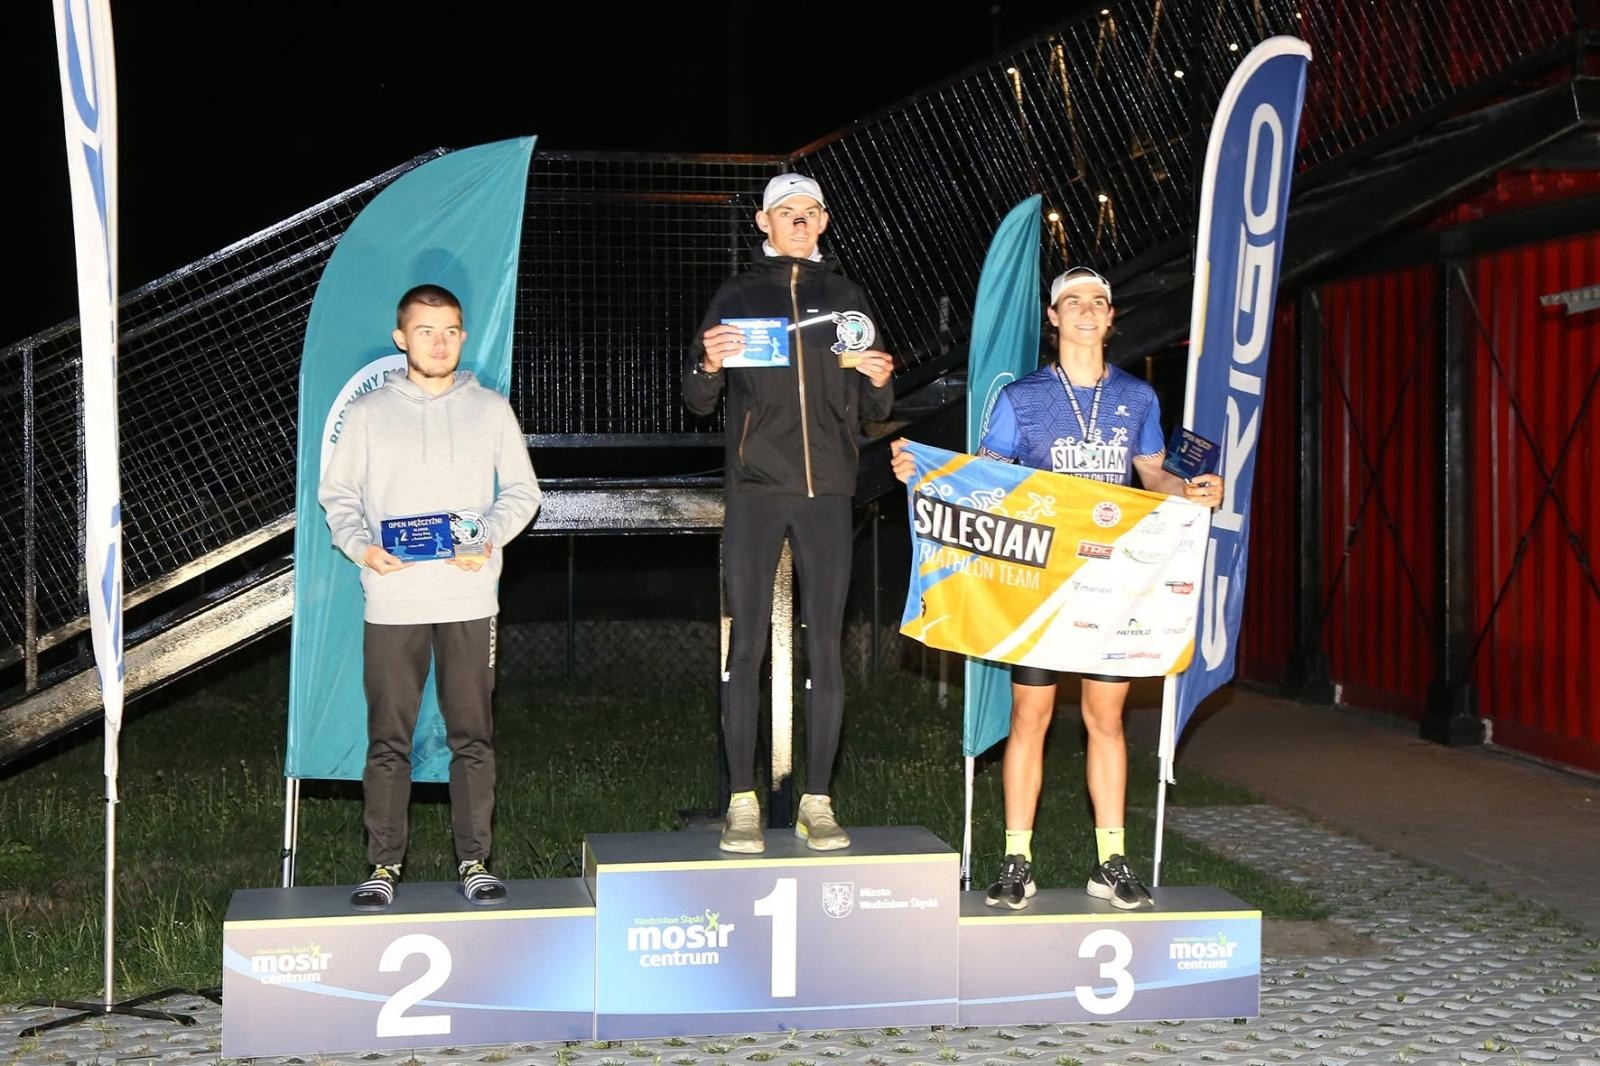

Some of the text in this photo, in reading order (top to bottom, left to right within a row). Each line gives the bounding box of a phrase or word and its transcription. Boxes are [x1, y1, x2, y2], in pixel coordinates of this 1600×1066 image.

[1055, 449, 1125, 471] SILIAN
[399, 529, 408, 542] 2
[914, 498, 1051, 564] SILESIAN
[998, 563, 1041, 590] TEAM
[627, 922, 735, 951] mosir
[753, 878, 797, 997] 1
[640, 950, 719, 968] centrum
[1074, 928, 1135, 1015] 3
[1177, 959, 1228, 970] centrum
[260, 972, 321, 985] centrum
[376, 933, 452, 1038] 2
